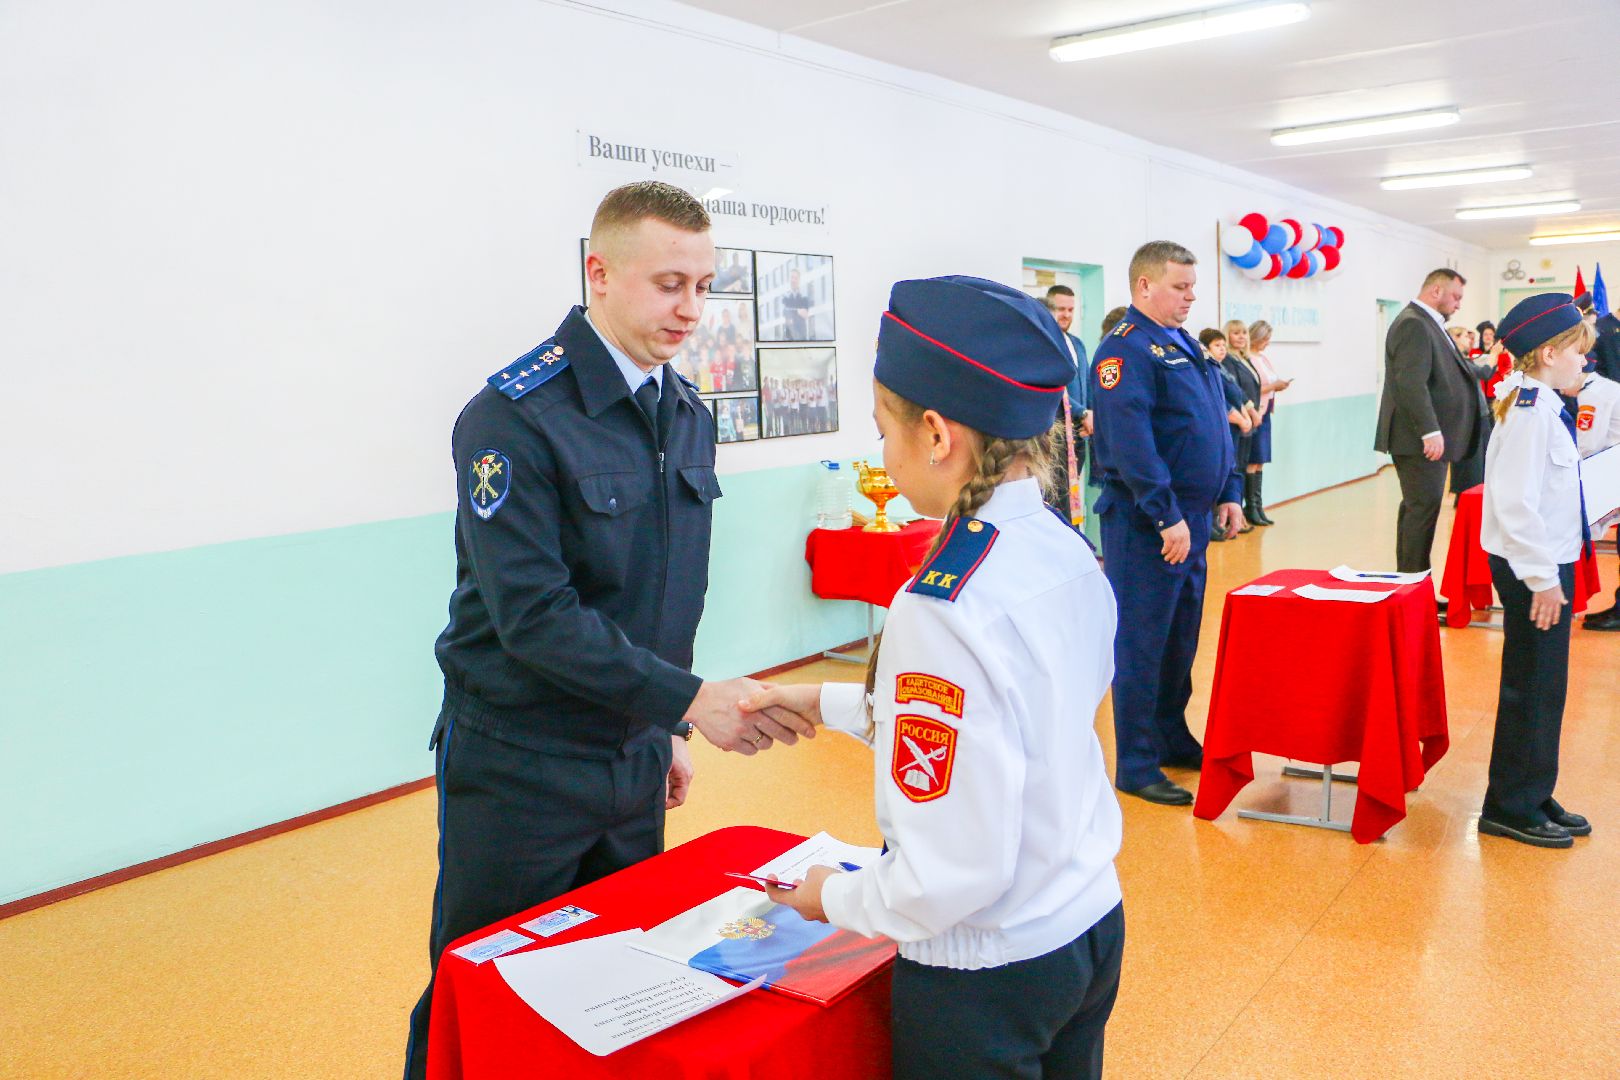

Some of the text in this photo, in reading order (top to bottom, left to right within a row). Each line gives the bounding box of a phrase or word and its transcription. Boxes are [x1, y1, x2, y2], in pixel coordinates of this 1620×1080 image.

[588, 135, 647, 164] Ваши
[652, 149, 716, 173] успехи
[752, 203, 825, 226] гордость!
[921, 570, 958, 589] КК
[901, 722, 950, 745] РОССИЯ
